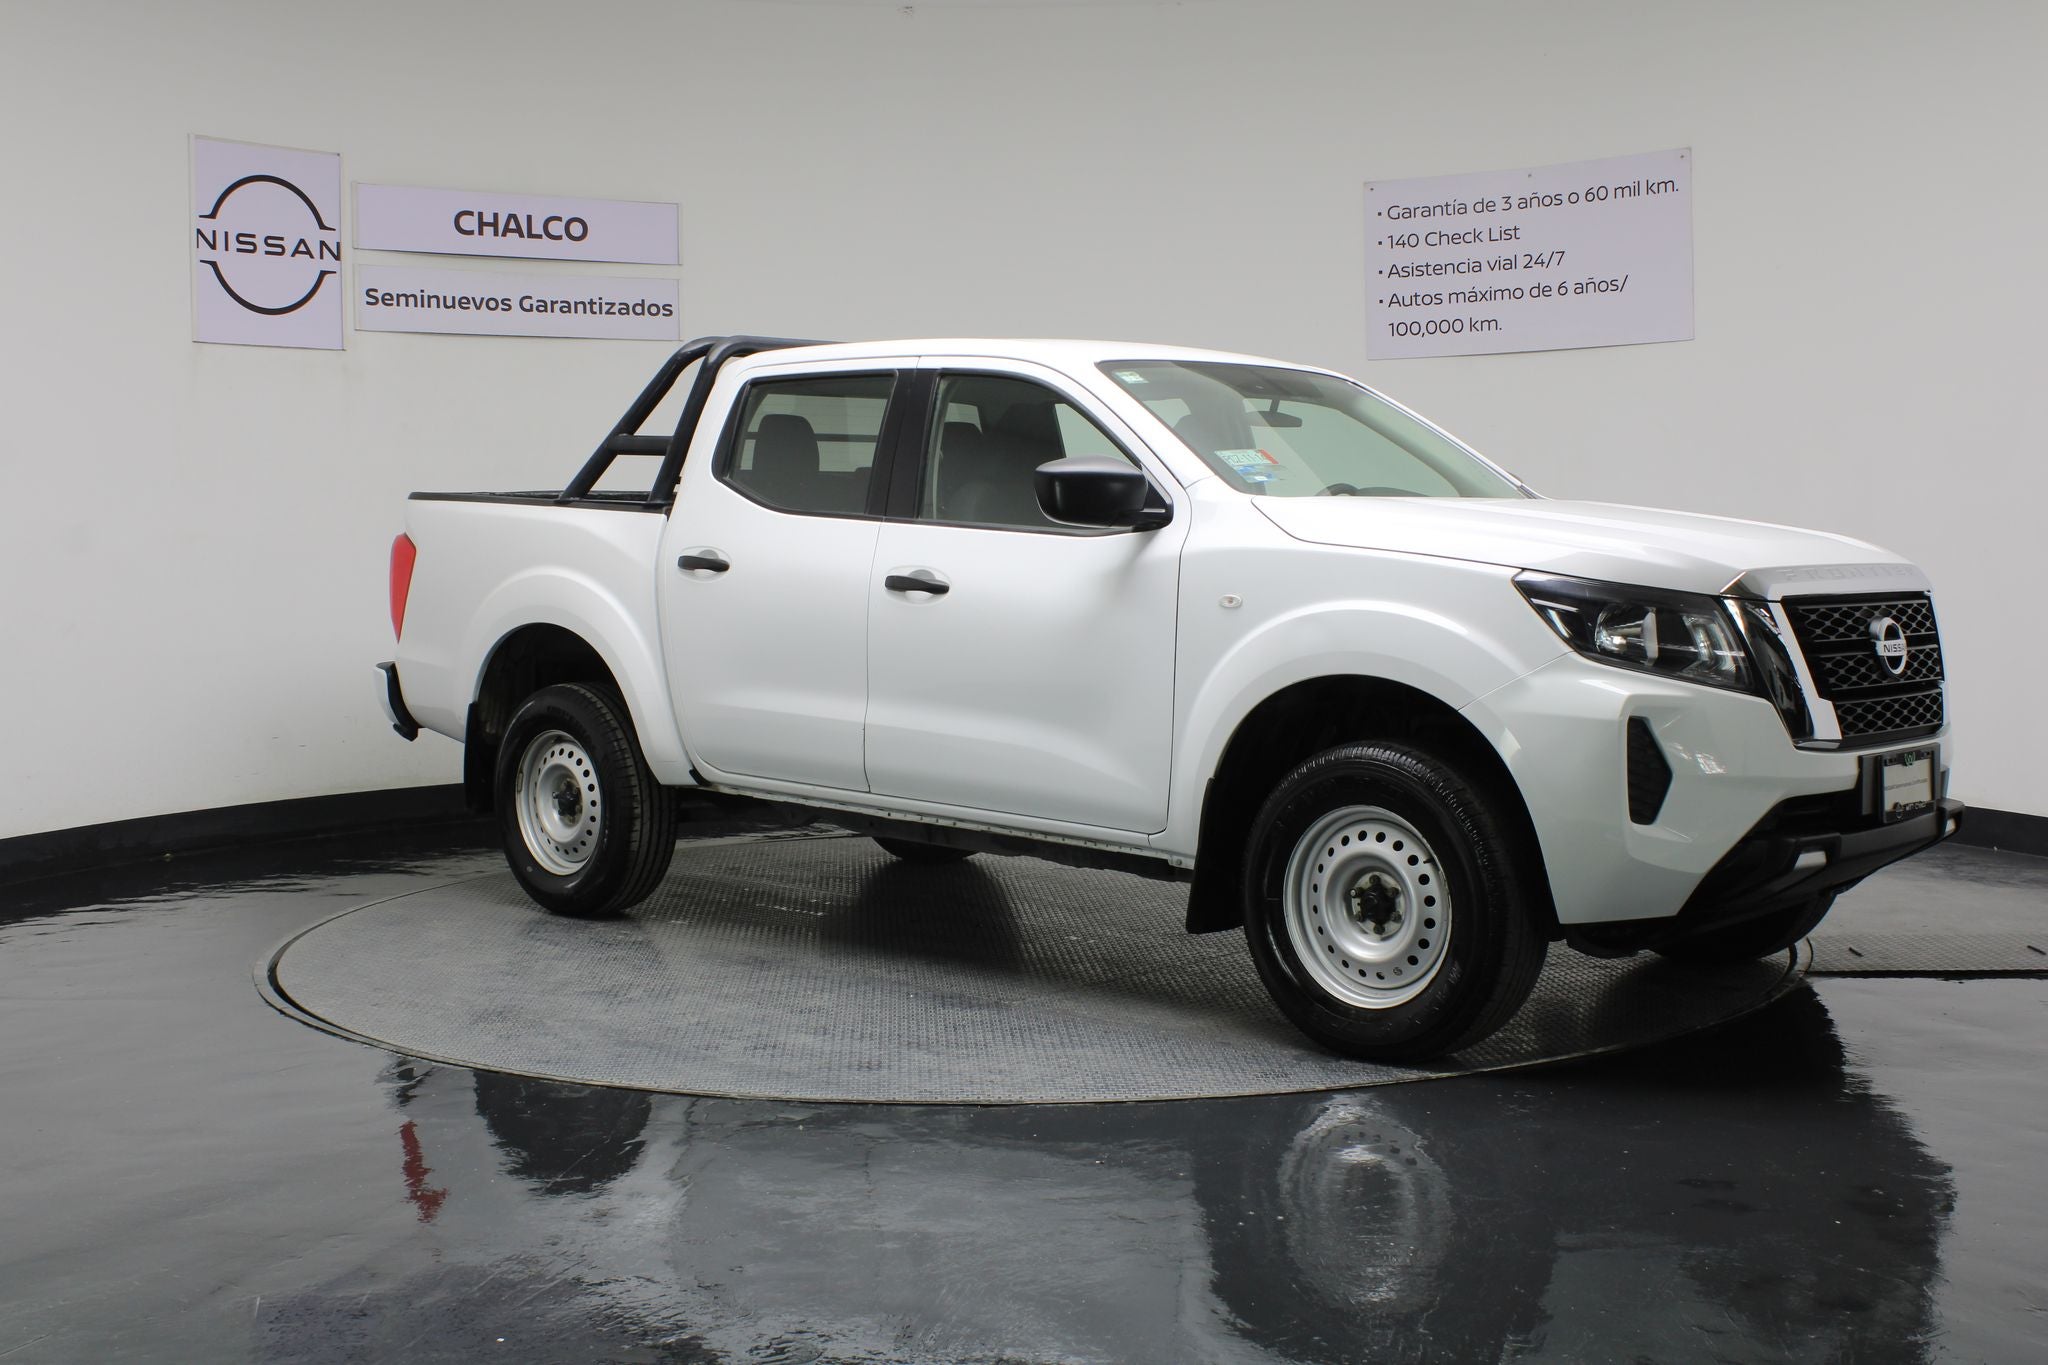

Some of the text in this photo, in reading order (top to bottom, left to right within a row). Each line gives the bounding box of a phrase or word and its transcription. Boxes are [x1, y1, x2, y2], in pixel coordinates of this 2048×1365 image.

[1387, 179, 1679, 220] Garantía de 3 años o 60 mil km.
[454, 210, 588, 242] CHALCO
[1388, 225, 1520, 249] 140 Check List
[196, 228, 341, 261] NISSAN
[1388, 251, 1566, 278] Asistencia vial 24/7
[366, 288, 674, 317] Seminuevos Garantizados
[1388, 275, 1629, 308] Autos máximo de 6 años/
[1388, 316, 1503, 338] 100,000 km.
